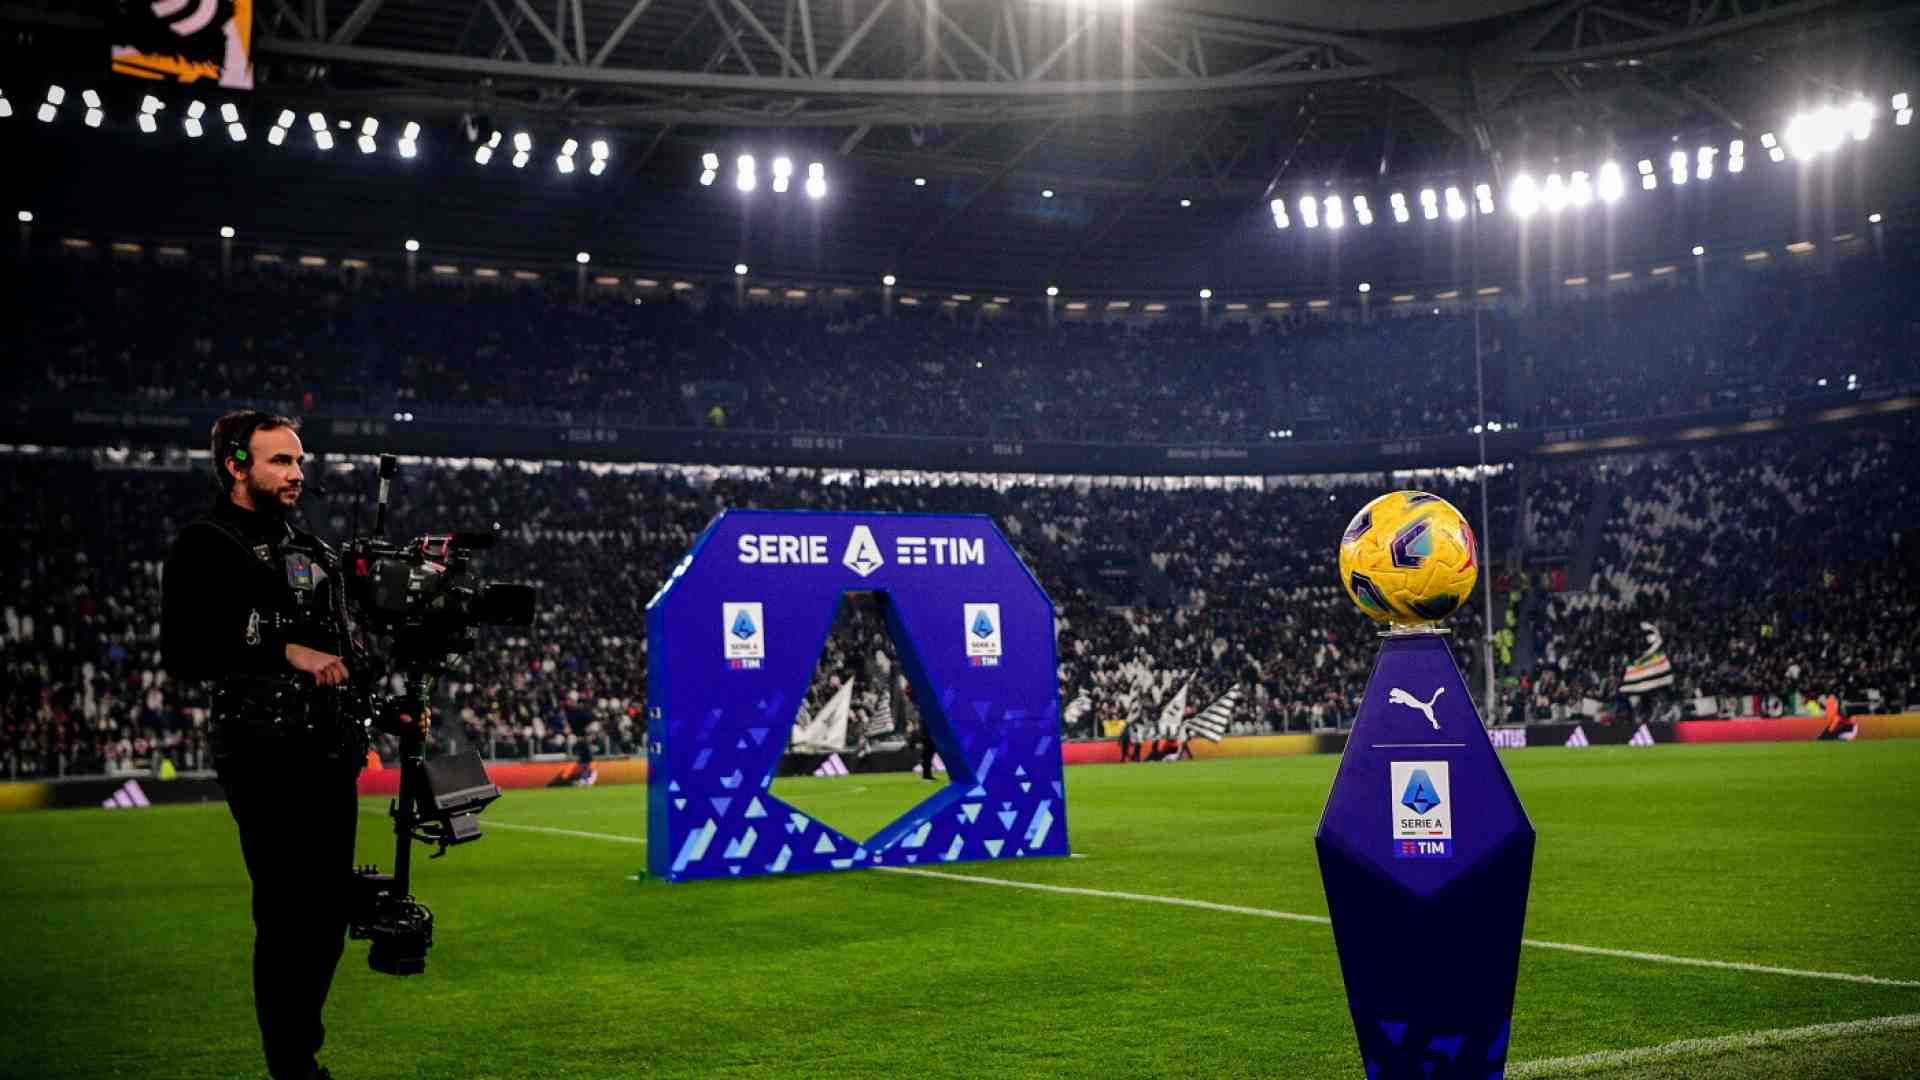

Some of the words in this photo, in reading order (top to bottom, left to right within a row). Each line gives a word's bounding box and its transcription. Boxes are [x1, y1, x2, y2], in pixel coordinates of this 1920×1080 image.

[738, 534, 829, 564] SERIE
[929, 537, 985, 565] TIM
[1400, 818, 1433, 829] SERIE
[1434, 818, 1442, 829] A
[1418, 841, 1445, 854] TIM
